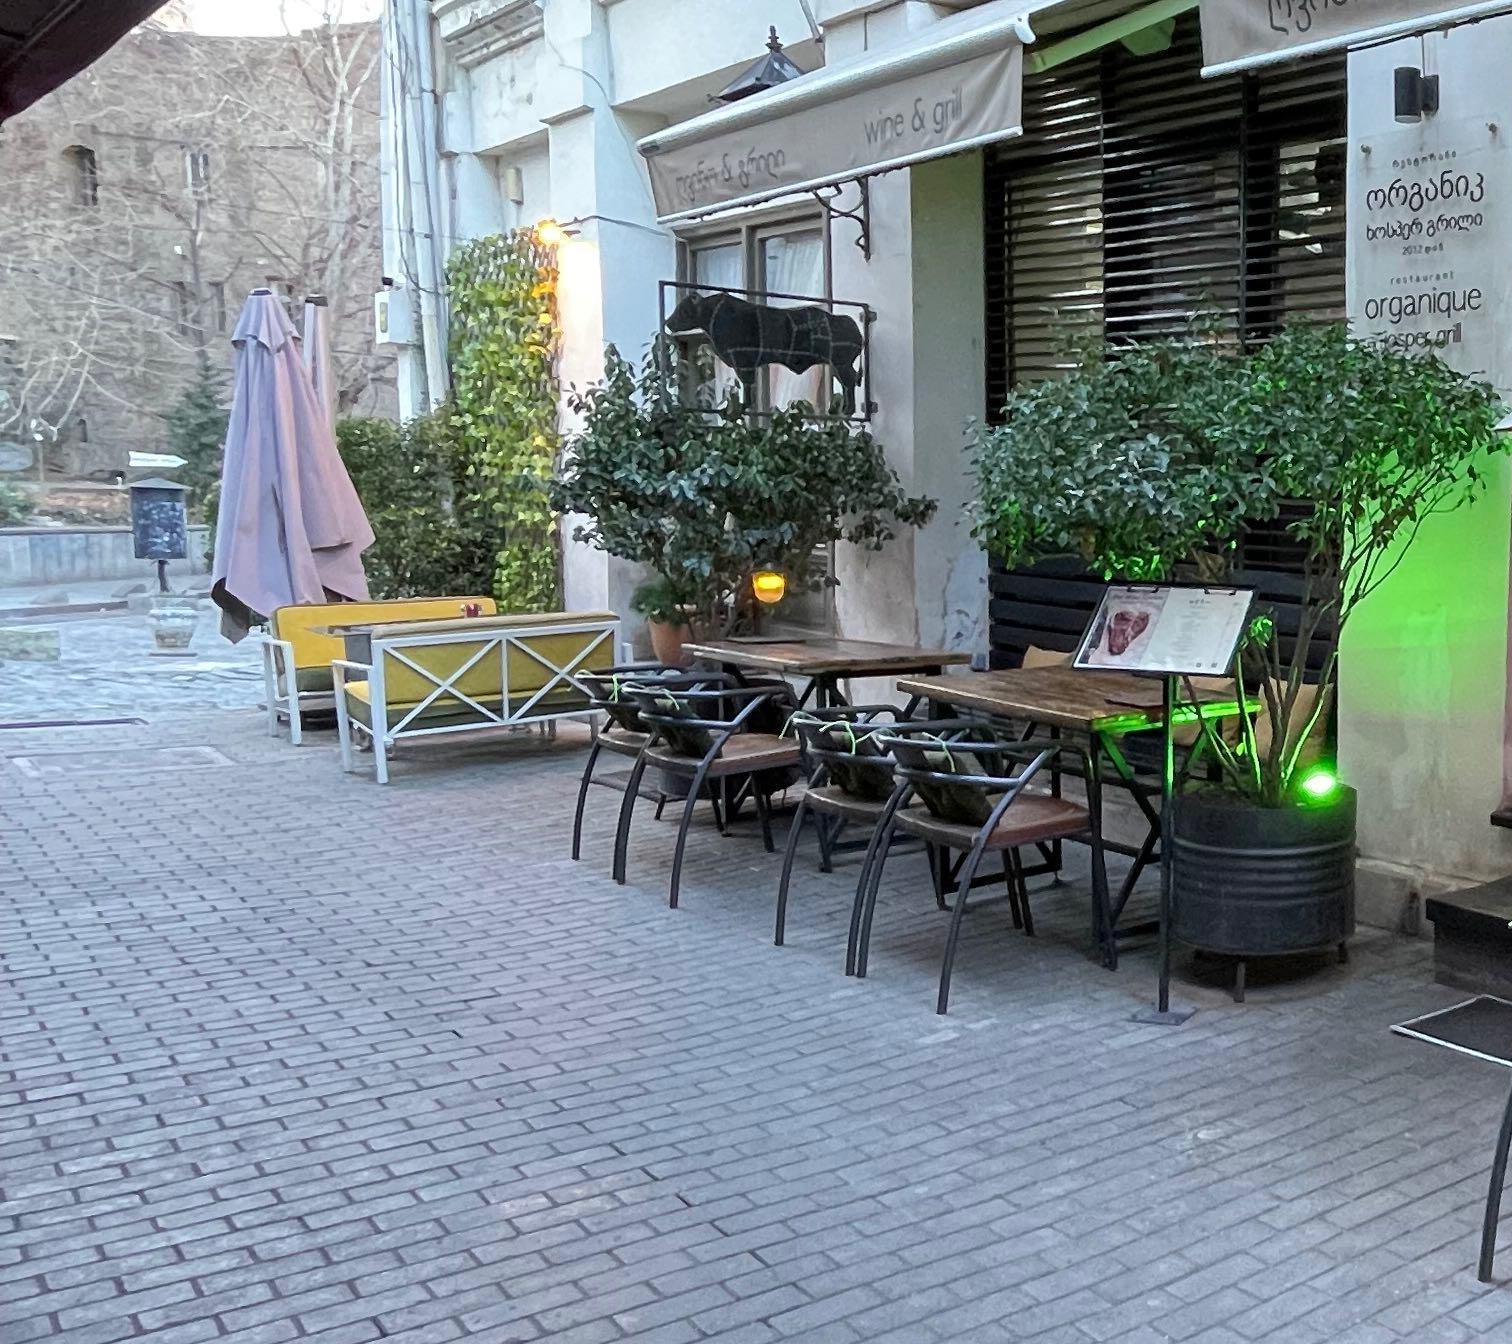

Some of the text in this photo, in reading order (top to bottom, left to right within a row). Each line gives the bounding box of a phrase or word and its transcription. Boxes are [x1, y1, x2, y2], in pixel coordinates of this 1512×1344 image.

[863, 87, 963, 144] wine & grill
[720, 153, 733, 182] &
[1366, 170, 1484, 212] ორგანიკ
[1426, 212, 1483, 238] გრილი
[1390, 271, 1454, 285] restaurant
[1365, 287, 1482, 325] organique
[1383, 331, 1430, 356] osper
